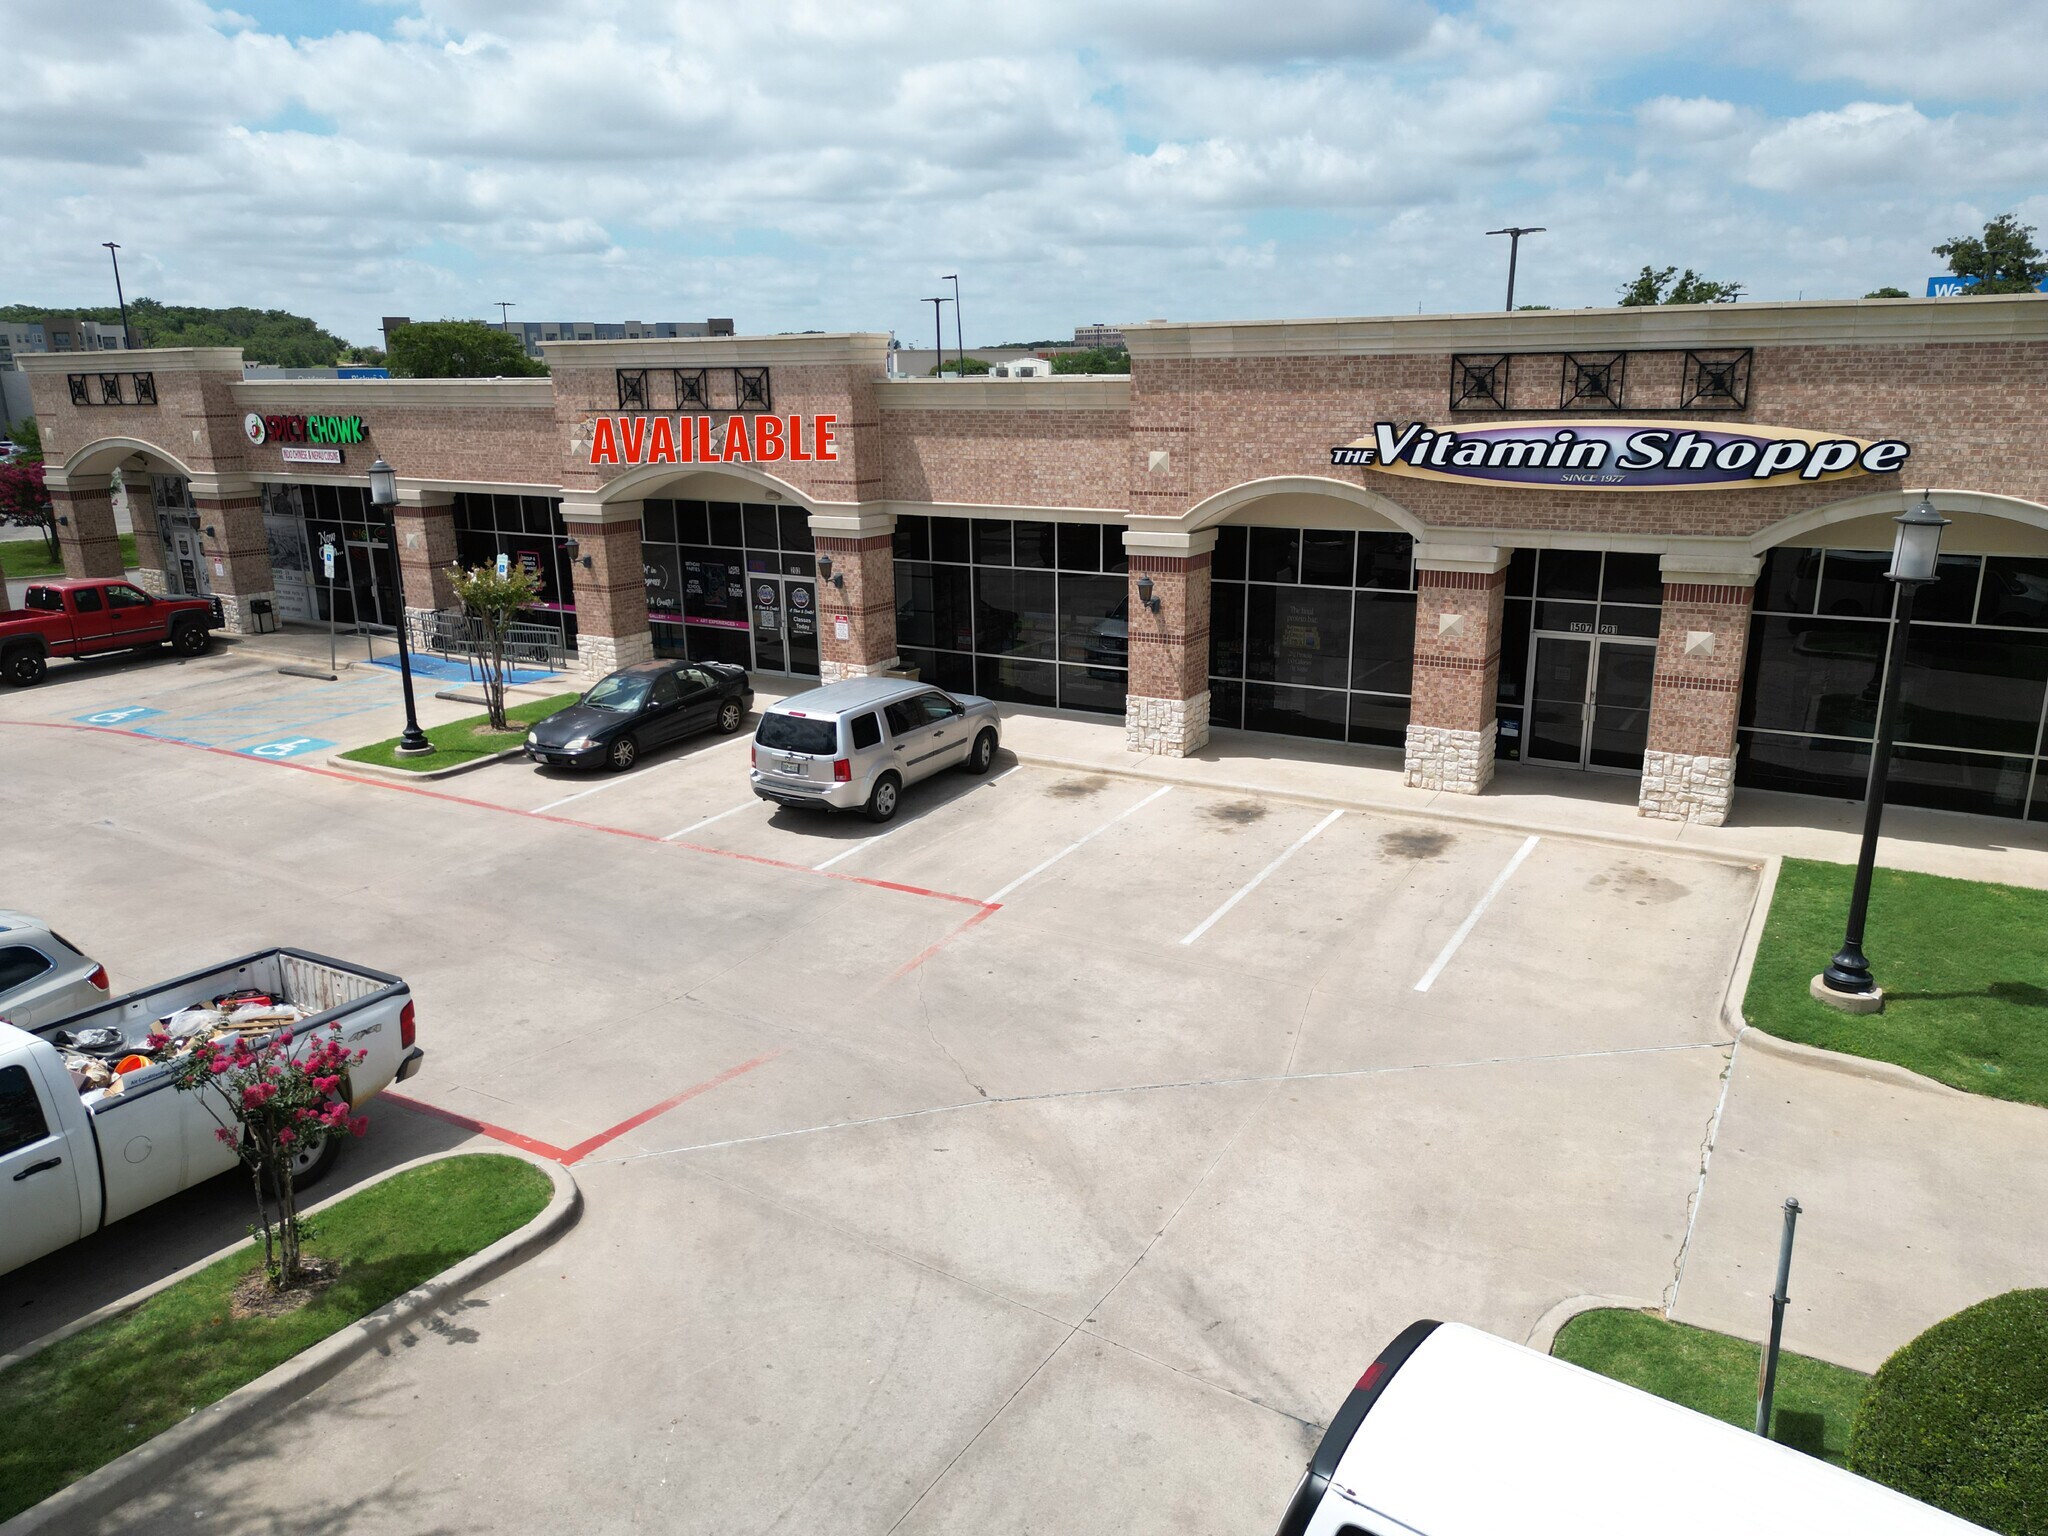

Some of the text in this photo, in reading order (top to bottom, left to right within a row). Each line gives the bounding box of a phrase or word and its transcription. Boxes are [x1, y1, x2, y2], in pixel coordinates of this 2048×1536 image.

[265, 415, 363, 444] SPICY CHOWK
[1331, 423, 1909, 479] THE Vitamin Shoppe
[1560, 473, 1627, 483] SINCE 1977
[318, 531, 336, 545] Now
[708, 620, 736, 628] EXPERIENCES
[795, 623, 810, 631] Today
[1570, 622, 1593, 633] 1507
[1601, 624, 1618, 634] 201
